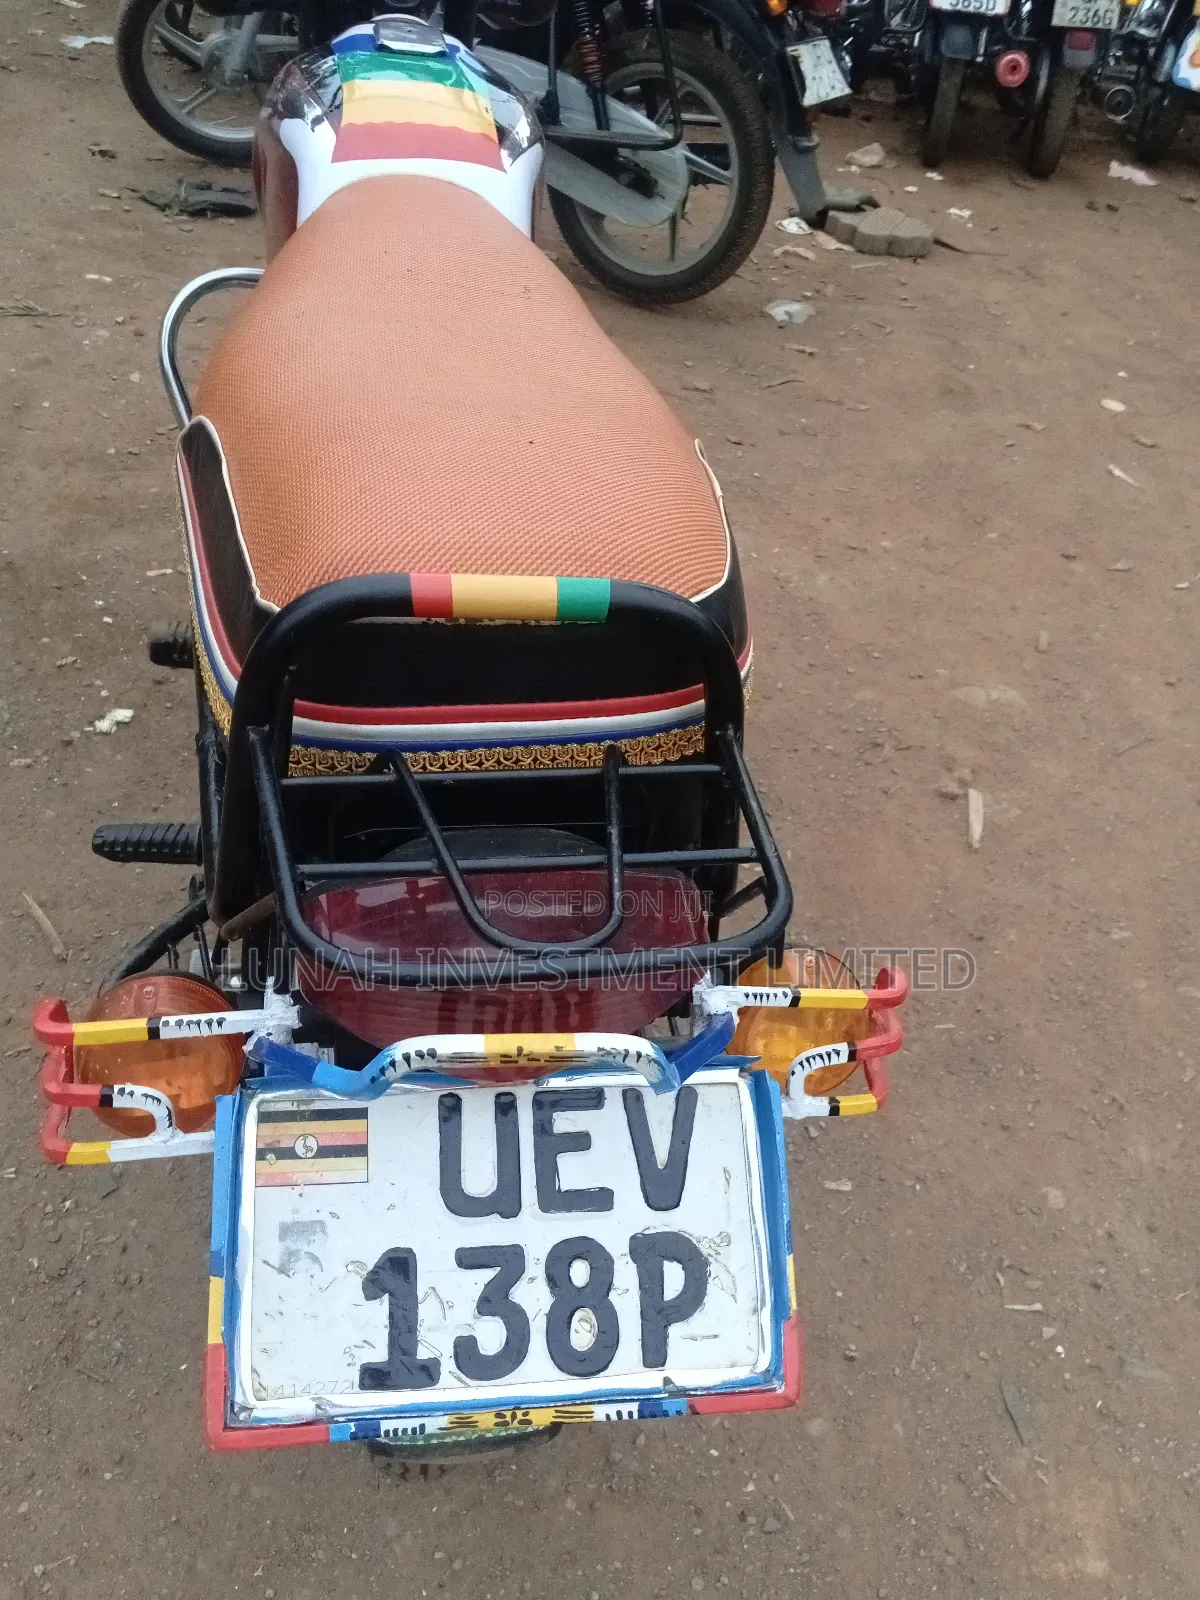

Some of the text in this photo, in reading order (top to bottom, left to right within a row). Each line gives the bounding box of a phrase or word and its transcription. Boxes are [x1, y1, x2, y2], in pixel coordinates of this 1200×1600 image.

[1068, 6, 1114, 26] 236G
[437, 1086, 700, 1219] UEV
[358, 1230, 711, 1391] 138P
